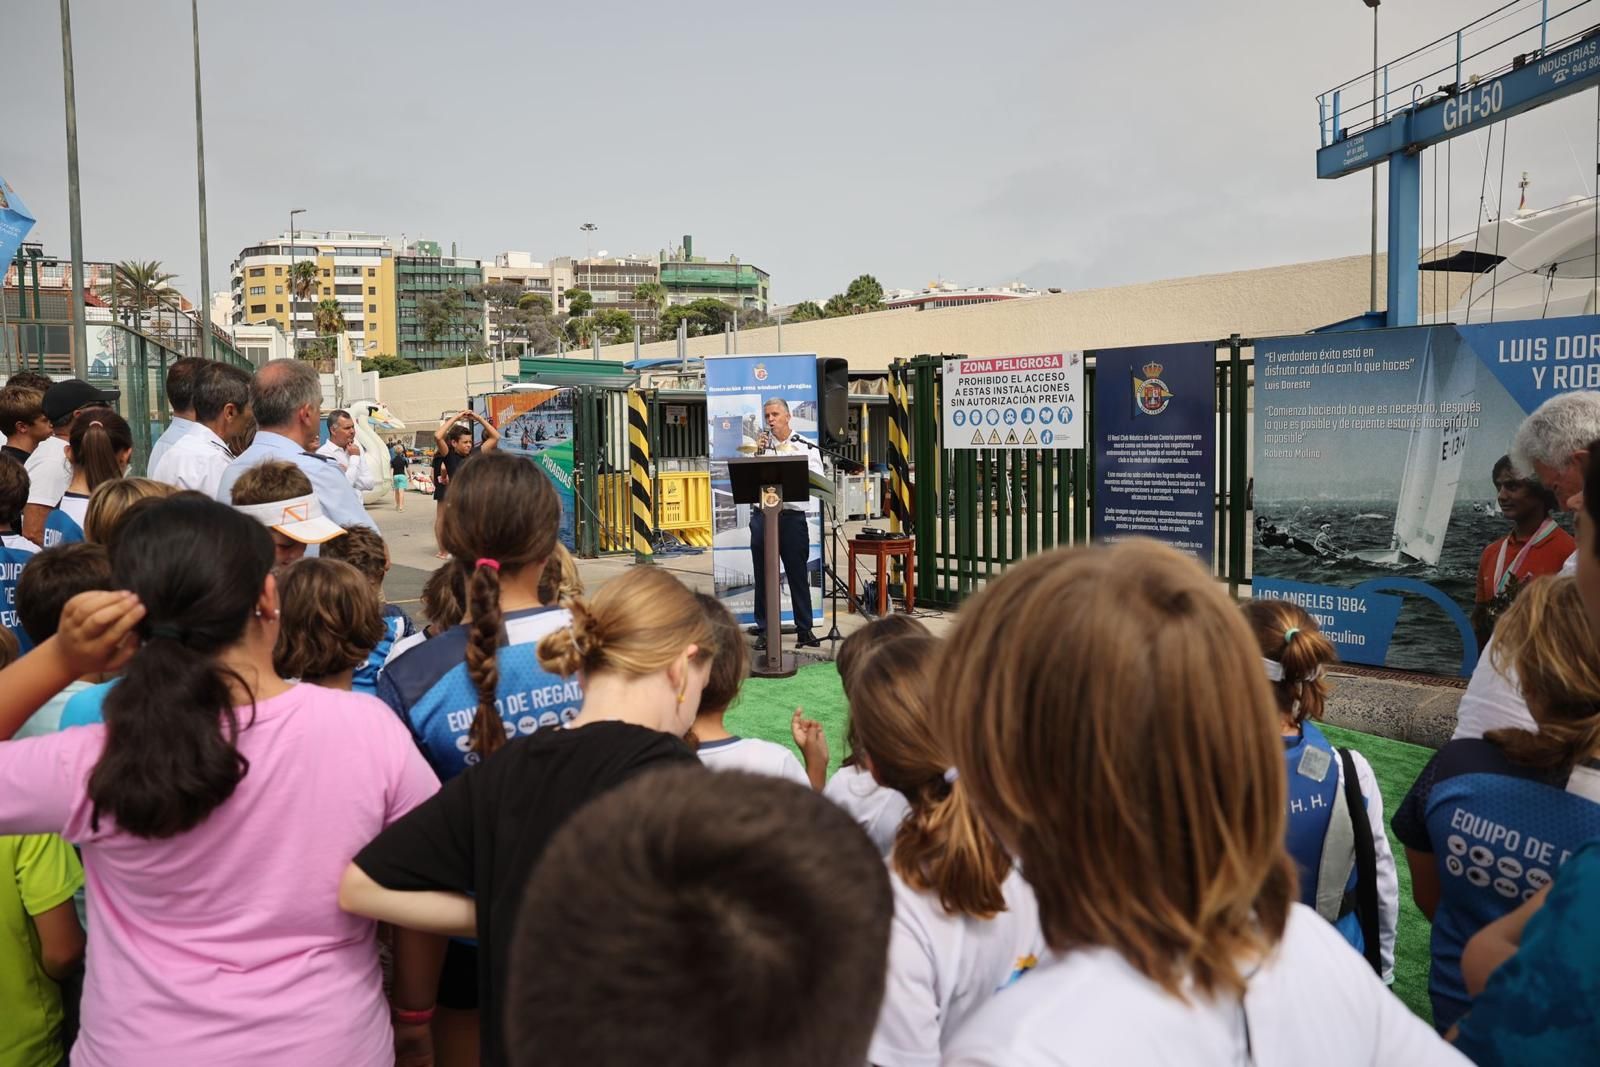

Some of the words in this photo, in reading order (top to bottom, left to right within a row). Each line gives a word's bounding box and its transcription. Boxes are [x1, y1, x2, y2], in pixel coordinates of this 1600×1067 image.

[1538, 41, 1596, 76] INDUSTRIAS
[1572, 60, 1587, 75] 943
[1589, 54, 1600, 69] 80
[1443, 80, 1503, 132] GH-50
[1277, 350, 1318, 363] verdadero
[1320, 348, 1340, 360] éxito
[1342, 348, 1362, 359] está
[1363, 348, 1374, 358] en
[1499, 338, 1547, 363] LUIS
[962, 362, 993, 373] ZONA
[996, 356, 1060, 371] PELIGROSA
[1264, 364, 1298, 377] disfrutar
[1300, 363, 1320, 375] cada
[1322, 362, 1334, 374] día
[1336, 364, 1352, 374] con
[1354, 361, 1362, 372] lo
[1364, 362, 1381, 374] que
[958, 376, 1008, 386] PROHIBIDO
[1011, 374, 1022, 383] EL
[1024, 372, 1066, 382] ACCESO
[1264, 380, 1280, 390] Luis
[1282, 380, 1311, 390] Doreste
[1532, 366, 1547, 390] Y
[1553, 364, 1600, 389] ROB
[955, 388, 961, 396] A
[962, 386, 991, 396] ESTAS
[994, 383, 1070, 394] INSTALACIONES
[951, 398, 965, 407] SIN
[967, 394, 1036, 406] AUTORIZACIÓN
[1038, 394, 1075, 404] PREVIA
[1308, 404, 1346, 416] haciendo
[1359, 405, 1375, 417] que
[1378, 404, 1388, 414] es
[1440, 400, 1480, 414] después
[1274, 420, 1288, 431] que
[1290, 420, 1298, 430] es
[1300, 418, 1330, 432] posible
[1332, 420, 1338, 432] y
[1340, 418, 1350, 429] de
[1352, 419, 1386, 432] repente
[1424, 415, 1468, 428] haciendo
[1265, 448, 1292, 458] Roberto
[1295, 448, 1320, 458] Molina
[542, 454, 572, 489] PIRAGUAS
[1337, 597, 1367, 614] 1984
[1319, 629, 1366, 646] sculino
[448, 700, 504, 733] EQUO
[506, 692, 529, 715] DE
[1451, 808, 1521, 852] EQUIPO
[1524, 836, 1555, 866] DE
